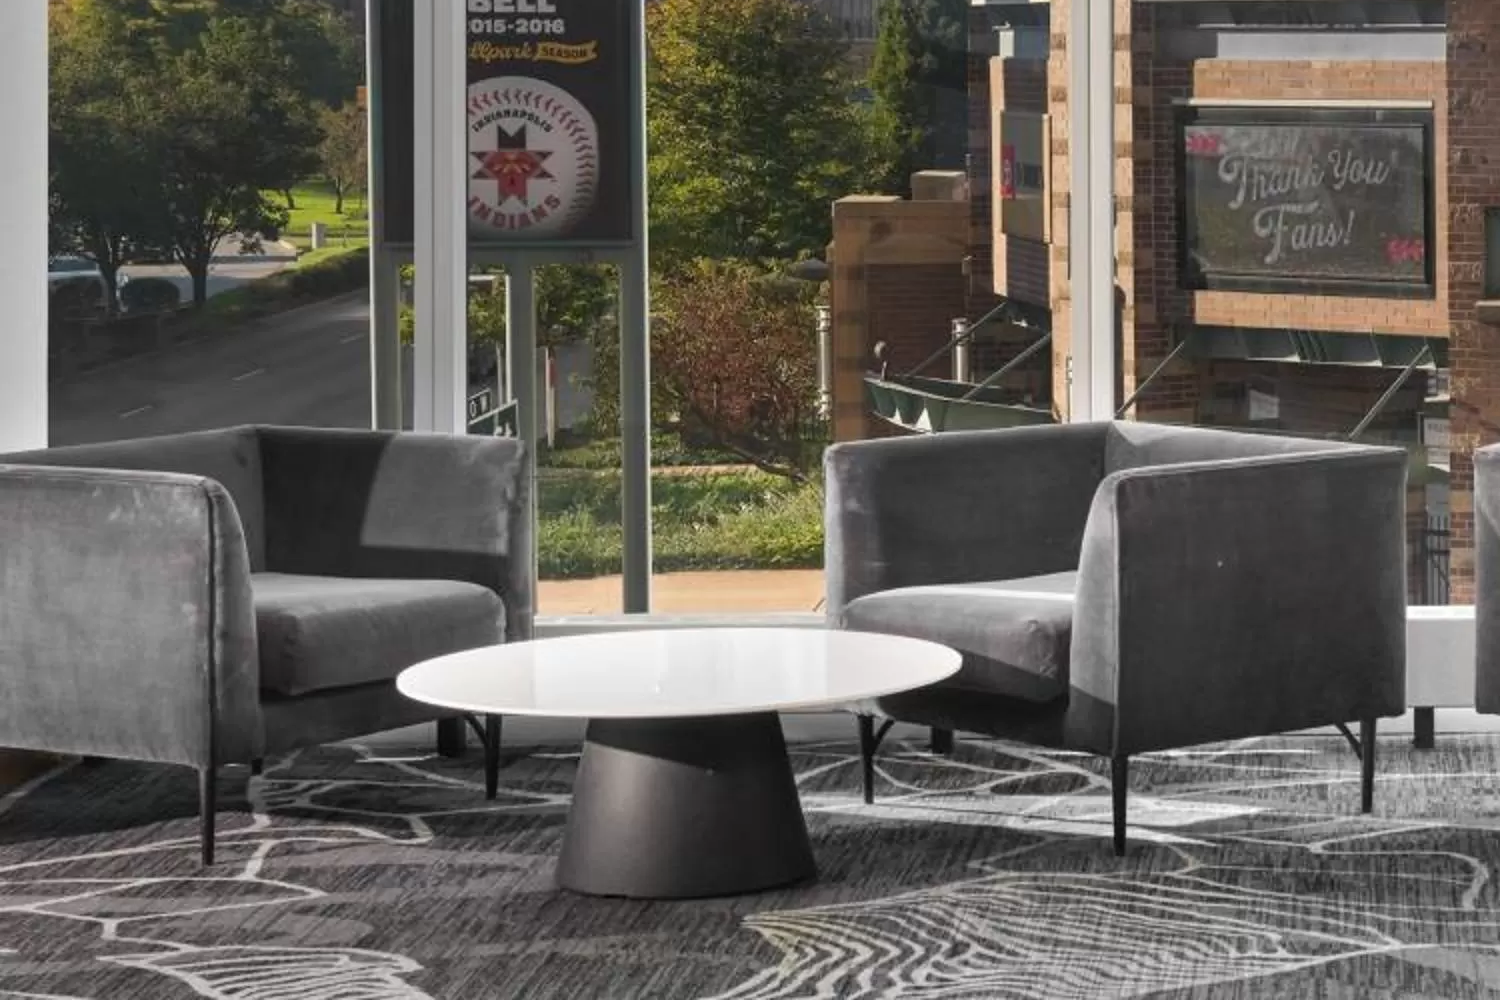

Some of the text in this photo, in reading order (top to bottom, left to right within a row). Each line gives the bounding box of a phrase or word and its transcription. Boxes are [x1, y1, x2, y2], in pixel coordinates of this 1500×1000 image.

[467, 18, 566, 35] 015-2016
[1218, 148, 1397, 210] Thank You
[467, 195, 562, 231] INDIANS
[1253, 199, 1356, 265] Fans!
